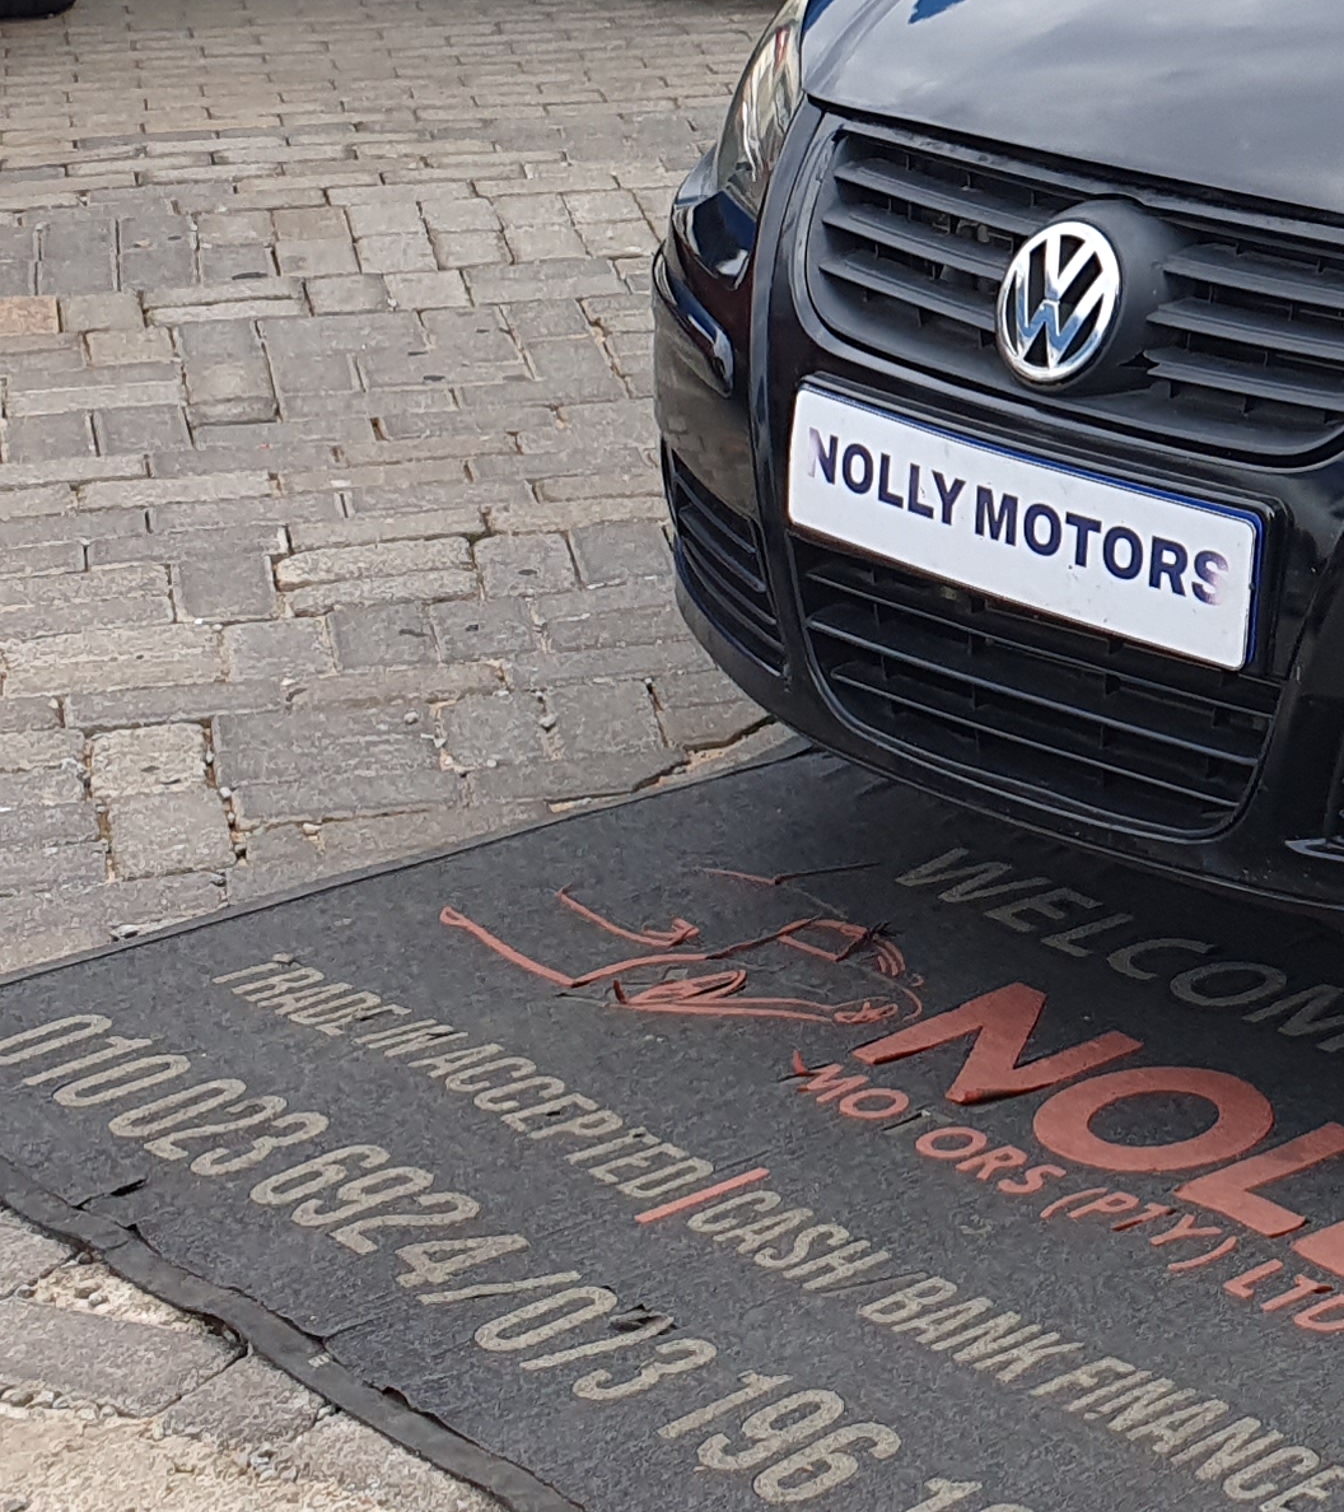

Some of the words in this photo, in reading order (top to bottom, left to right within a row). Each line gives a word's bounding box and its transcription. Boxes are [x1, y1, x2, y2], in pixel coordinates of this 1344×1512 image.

[808, 426, 966, 526] NOLLY
[974, 484, 1230, 607] MOTORS
[211, 951, 413, 1037] TRADE
[406, 1042, 715, 1199] ACCEPTED
[108, 1078, 329, 1176] 023
[658, 1369, 902, 1504] 196
